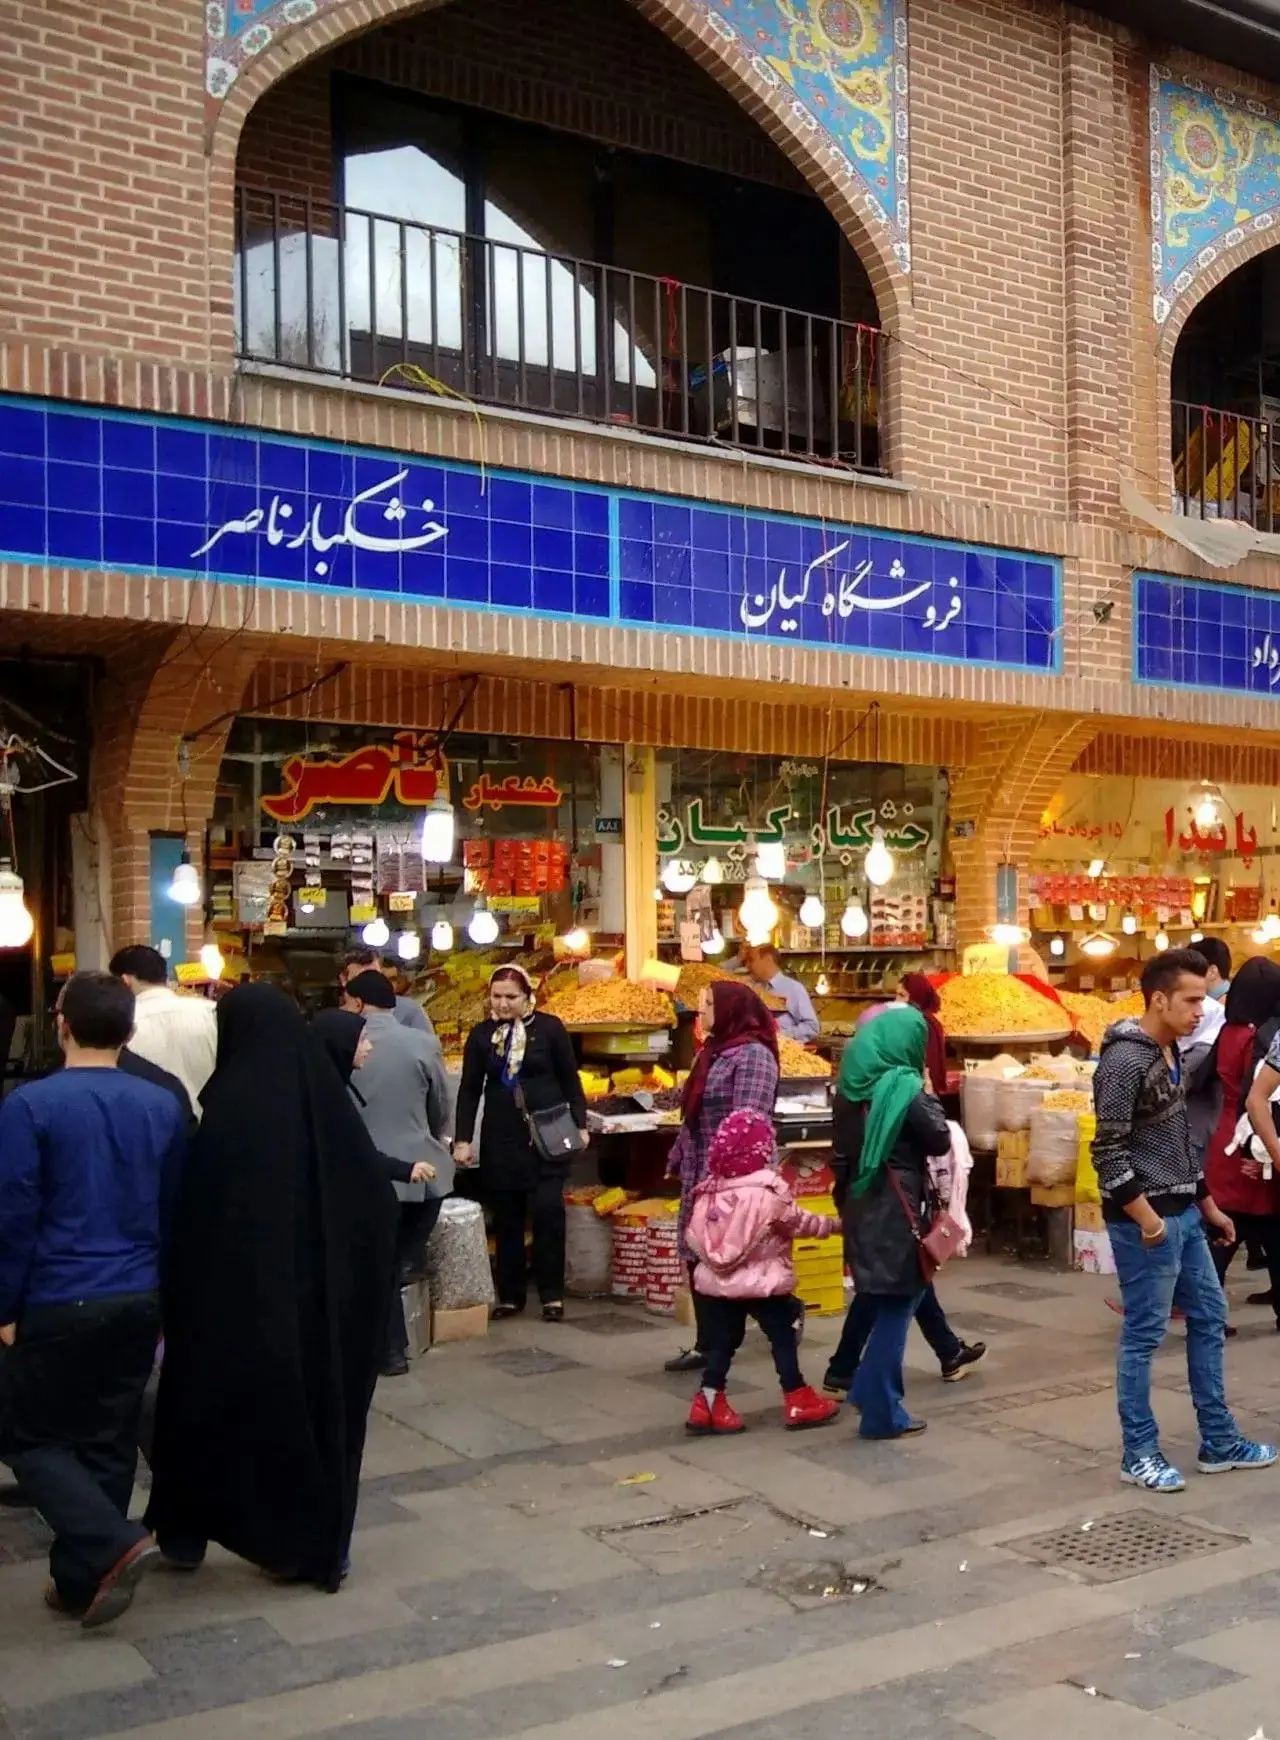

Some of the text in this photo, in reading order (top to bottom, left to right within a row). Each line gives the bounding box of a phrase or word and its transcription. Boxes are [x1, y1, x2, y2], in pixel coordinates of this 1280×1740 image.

[190, 468, 450, 575] خشکبار ناصر
[739, 540, 963, 632] فروشگاه کیان
